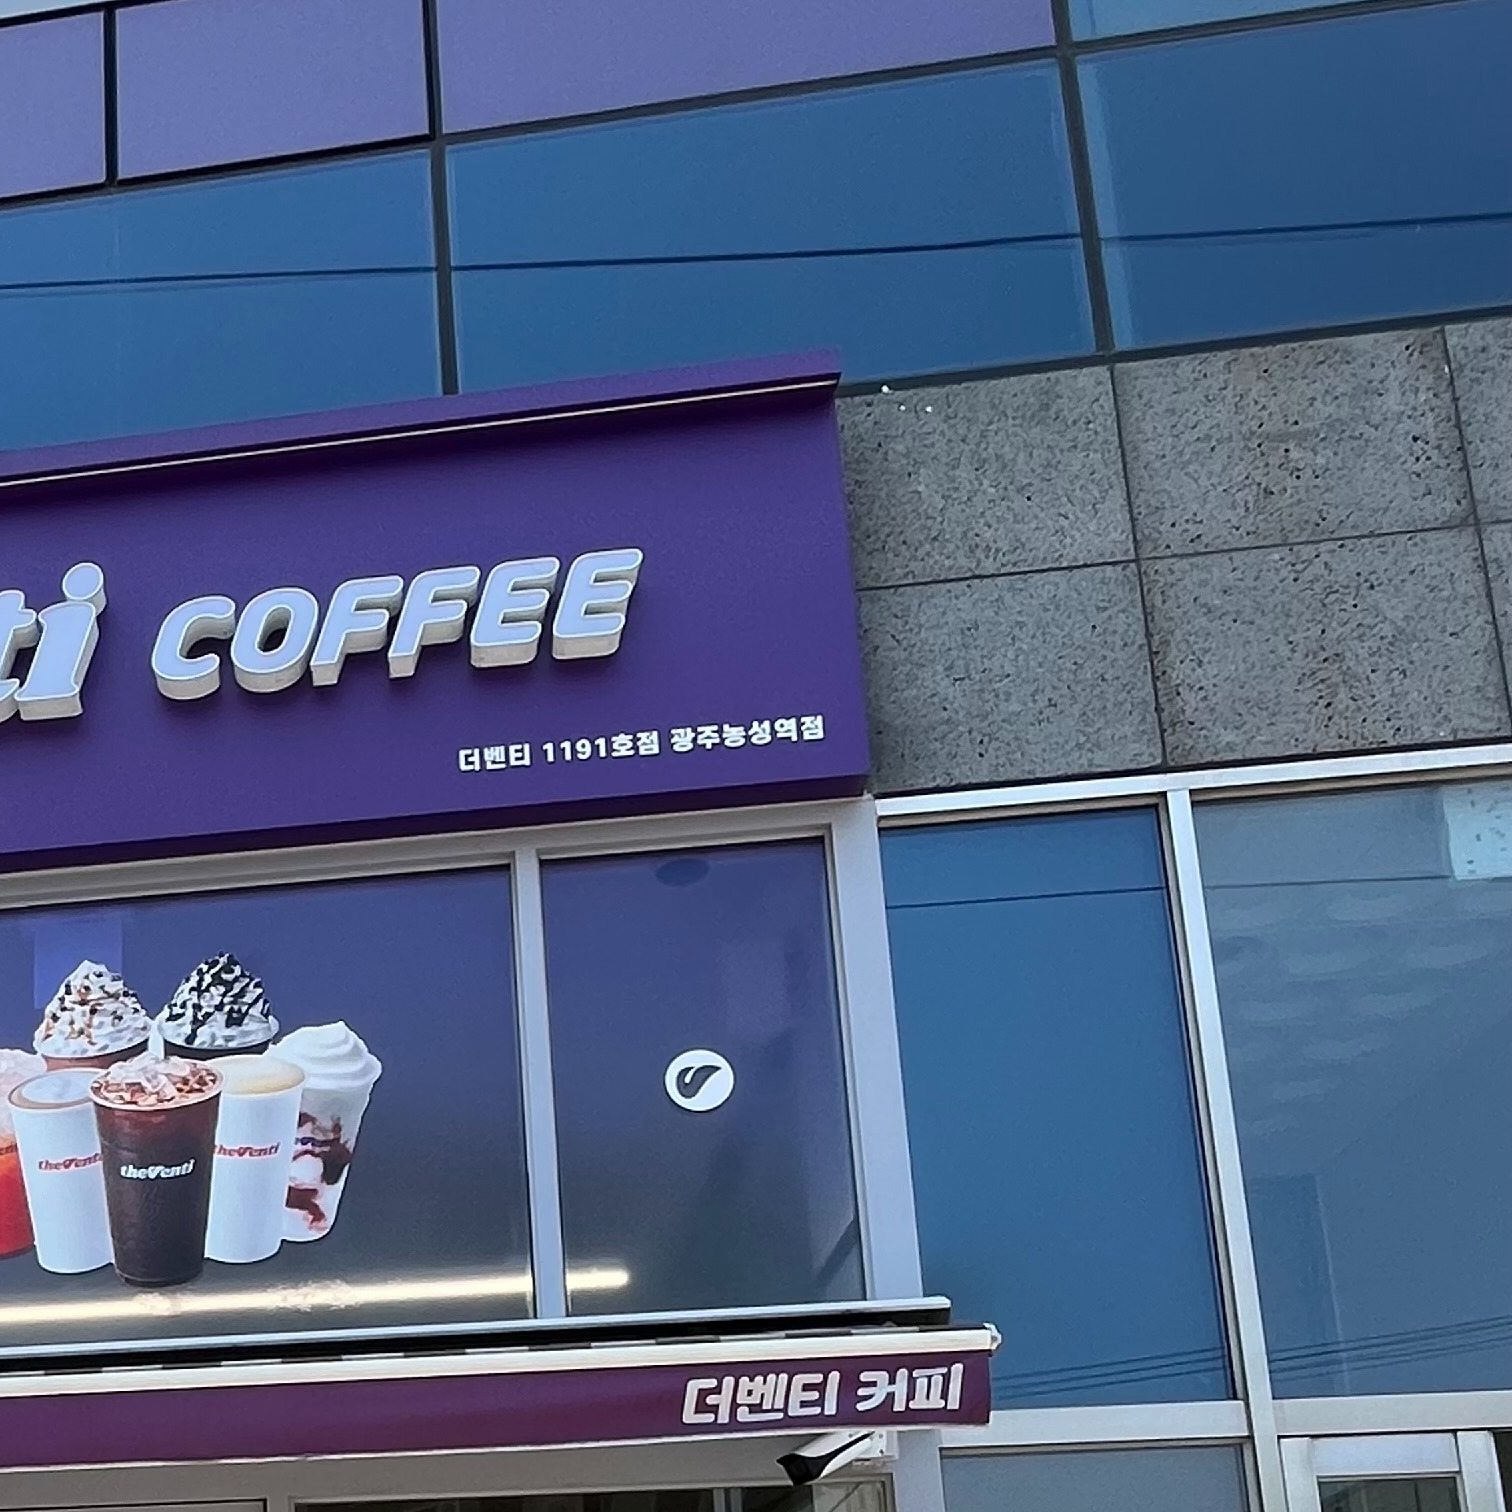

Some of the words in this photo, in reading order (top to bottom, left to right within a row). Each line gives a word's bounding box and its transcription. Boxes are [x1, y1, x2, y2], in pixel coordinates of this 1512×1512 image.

[152, 548, 643, 700] COFFEE
[458, 742, 532, 772] 더벤티
[543, 731, 661, 762] 1191호점
[670, 714, 826, 754] 광주농성역점
[120, 1158, 195, 1180] theVenti
[682, 1370, 841, 1424] 더벤티
[855, 1363, 965, 1412] 커피
